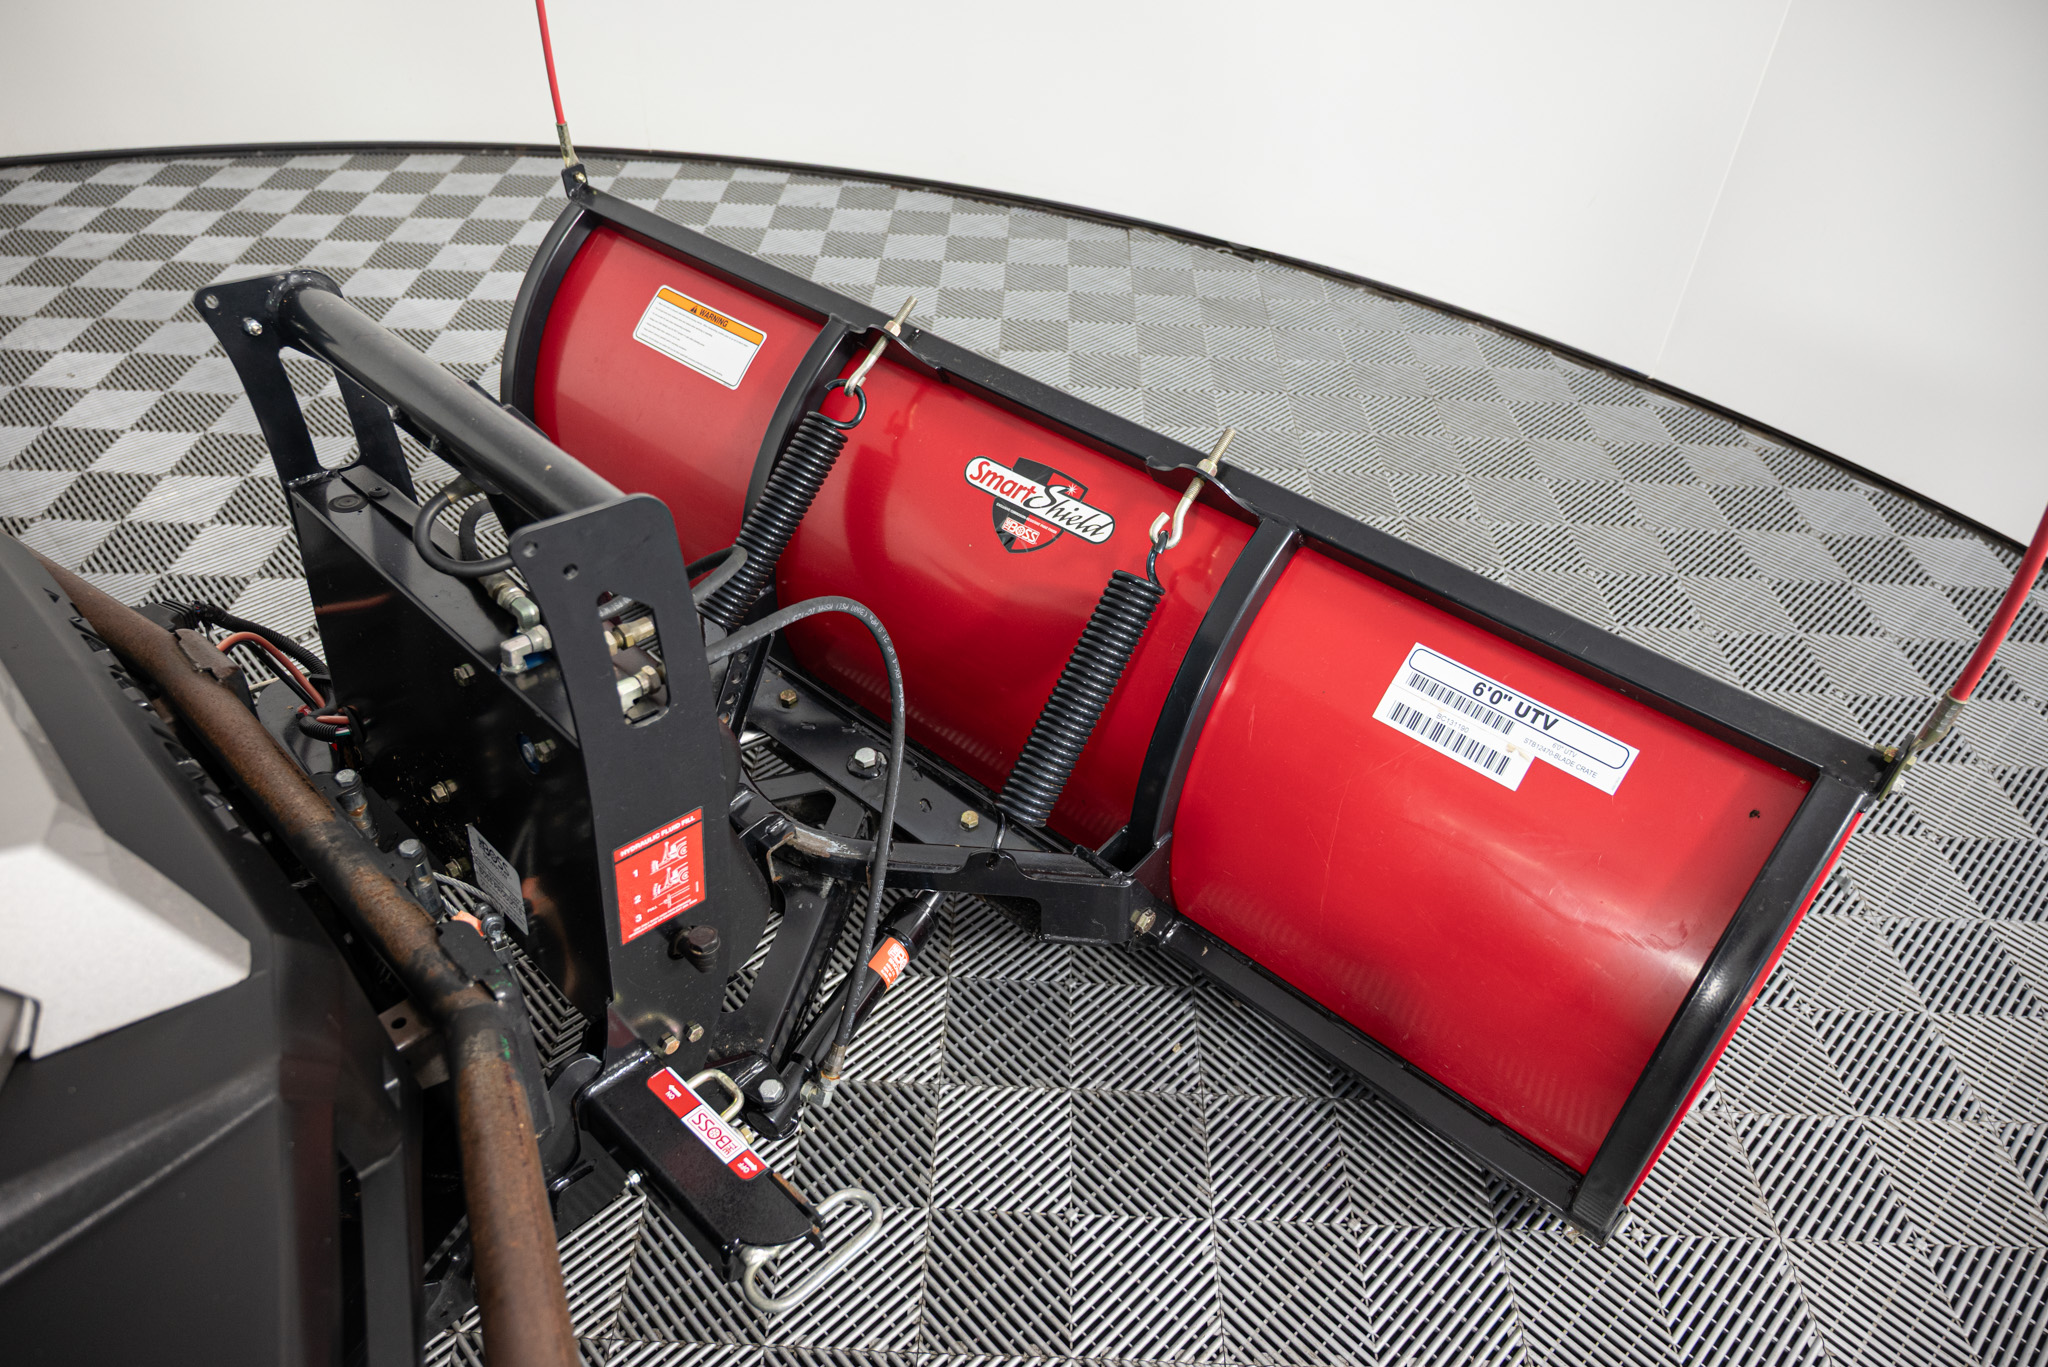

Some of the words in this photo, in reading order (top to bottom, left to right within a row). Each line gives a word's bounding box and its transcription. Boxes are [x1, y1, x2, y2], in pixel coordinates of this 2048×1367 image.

[699, 309, 729, 328] WARNING
[969, 461, 1036, 503] Smart
[1023, 484, 1113, 537] Shield
[1009, 524, 1040, 544] BOSS
[1472, 681, 1513, 705] 6'0"
[1514, 701, 1559, 731] UTV
[1563, 747, 1578, 758] UTV
[1575, 763, 1598, 779] CRATE
[620, 832, 661, 857] HYDRAULIC
[660, 822, 681, 837] FLUID
[681, 815, 696, 827] FILL
[632, 869, 639, 878] 1
[634, 894, 642, 904] 2
[635, 914, 643, 923] 3
[665, 1090, 676, 1101] ON
[692, 1113, 732, 1150] BOSS
[722, 1142, 738, 1155] THE
[737, 1162, 750, 1174] OFF
